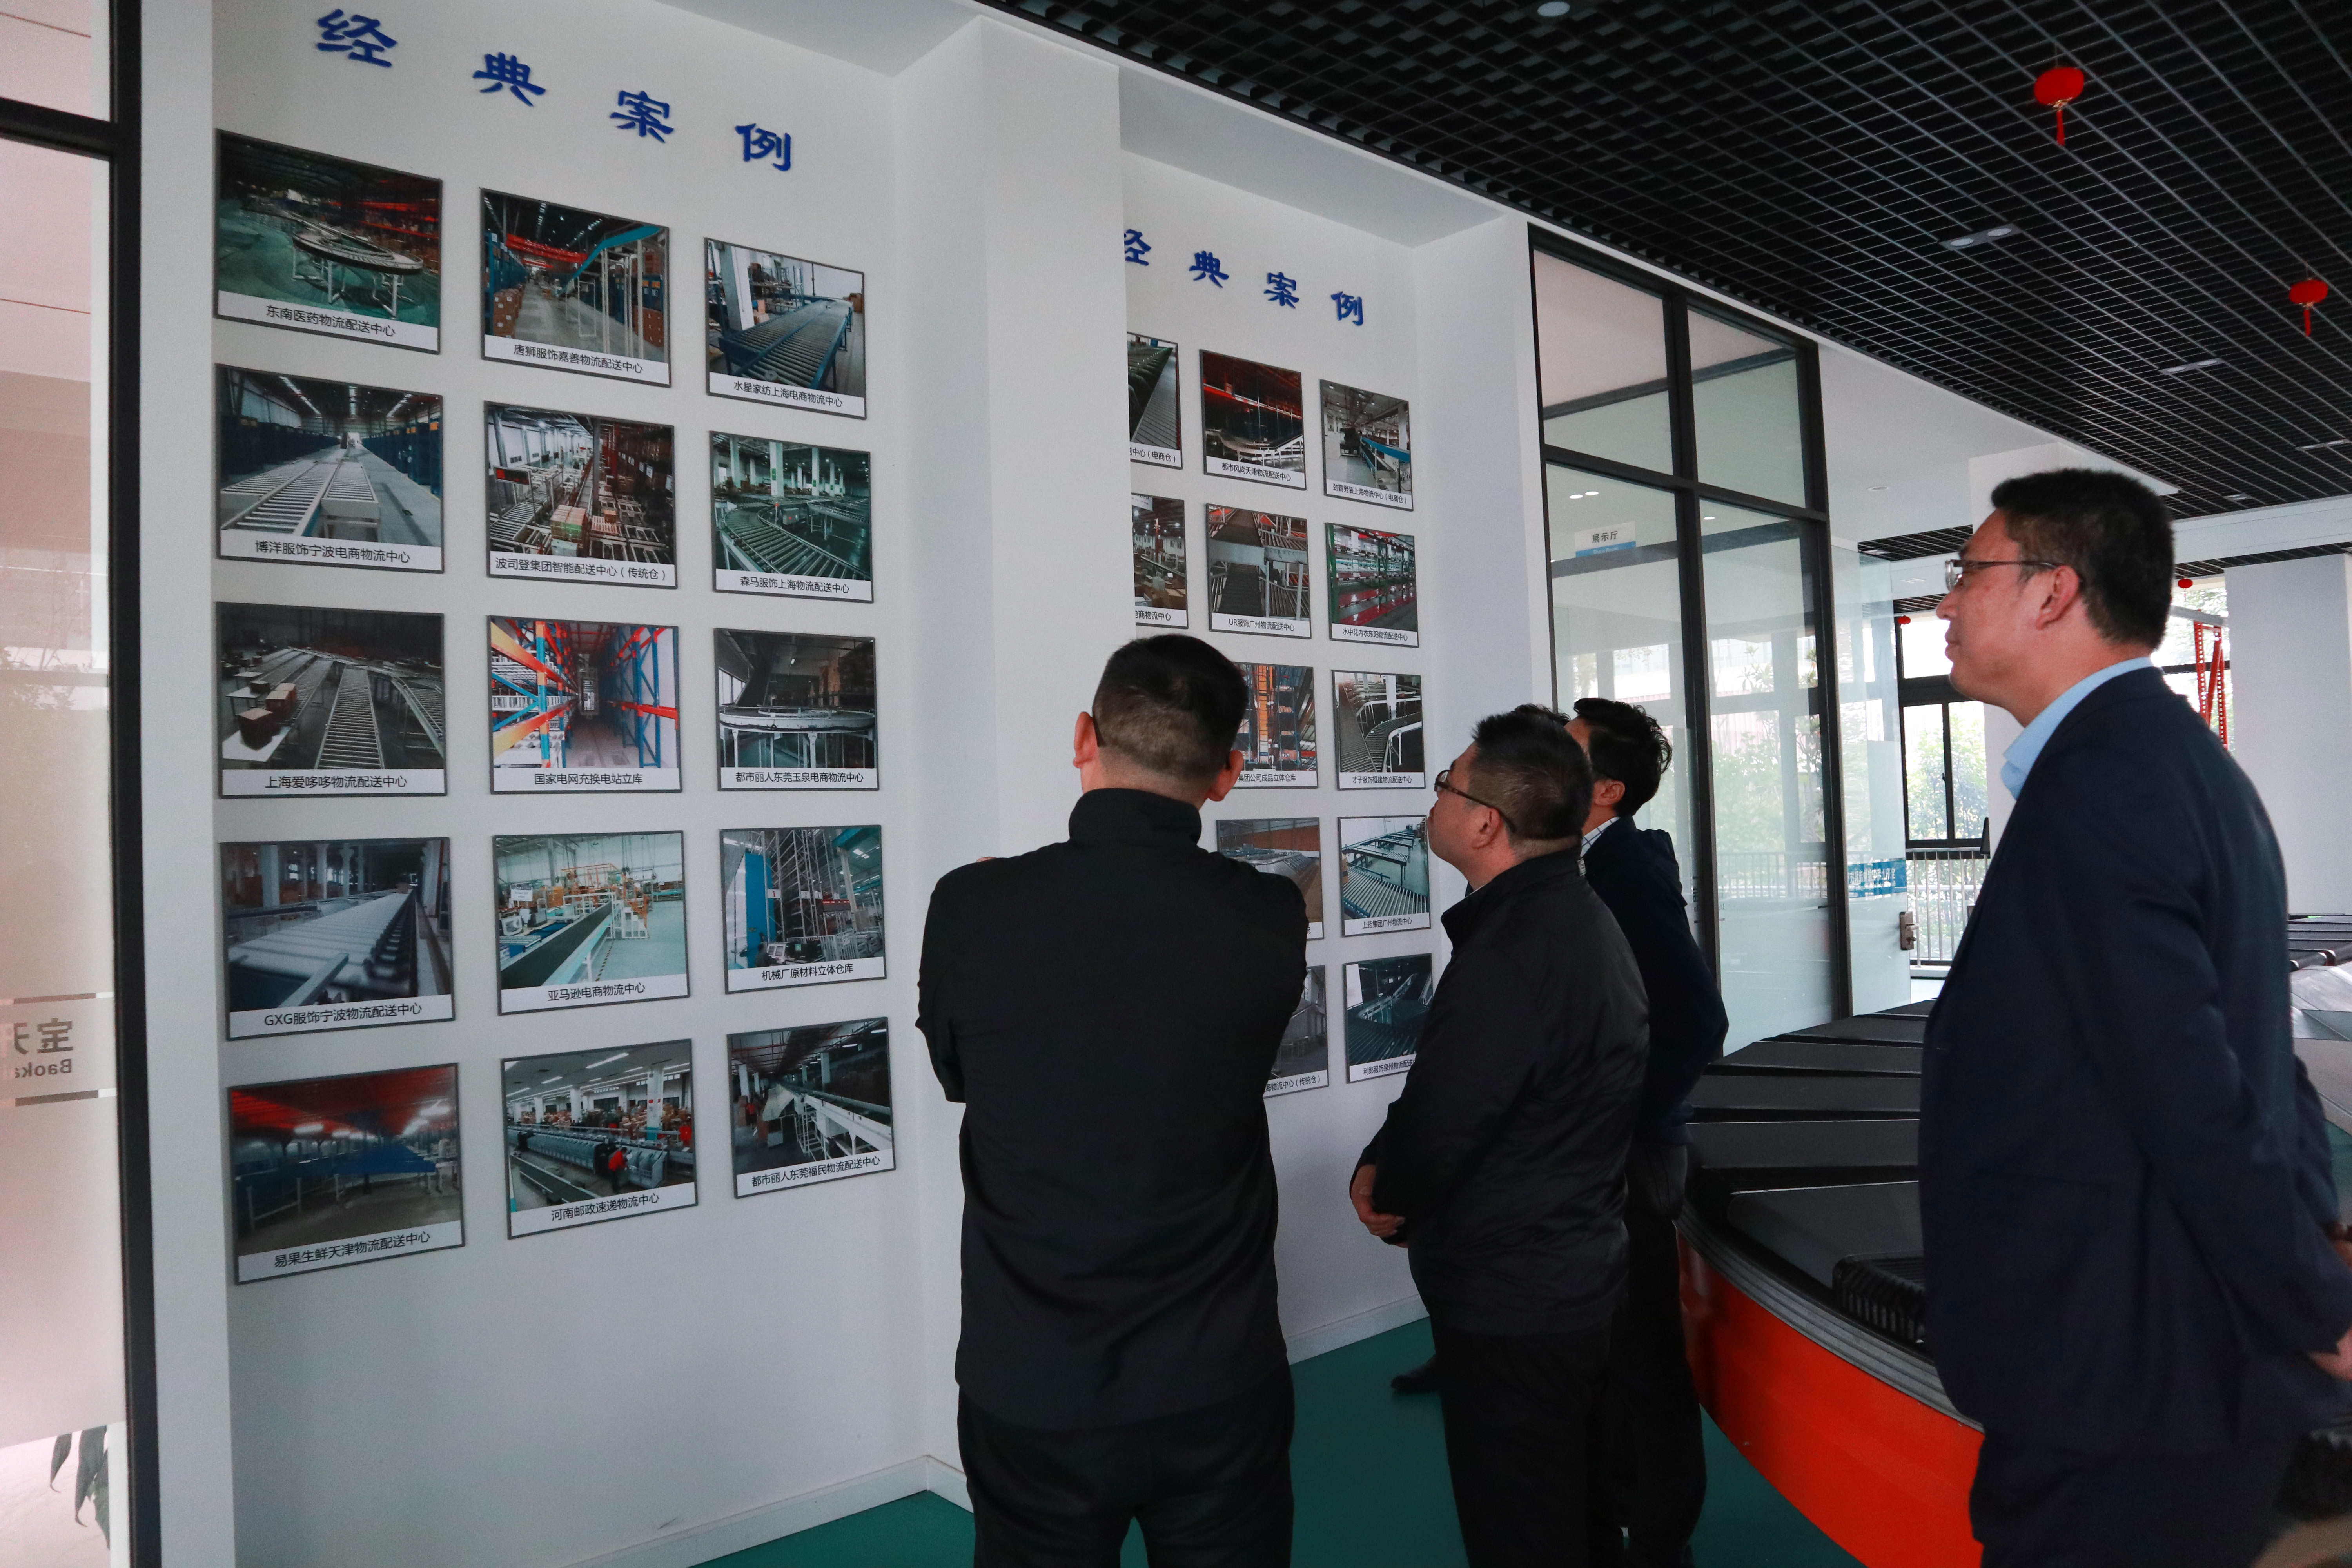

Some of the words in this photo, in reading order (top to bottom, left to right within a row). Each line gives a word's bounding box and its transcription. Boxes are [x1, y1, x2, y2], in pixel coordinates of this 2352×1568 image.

[316, 8, 794, 172] 经典案例
[266, 304, 395, 337] 东南医药物流配送中心
[514, 344, 643, 374] 唐狮服饰嘉善物流配送中心
[733, 381, 843, 407] 水星家纺上海电商物流中心
[1222, 462, 1291, 481] 都市风尚天津物流配送中心
[1592, 531, 1618, 543] 展示厅
[255, 540, 410, 563] 博洋服饰宁波电商物流中心
[740, 576, 850, 594] 森马服饰上海物流配送中心
[1229, 618, 1295, 632] UR服饰广州物流配送中心
[1343, 628, 1408, 641] 水中花内衣东阳物流配送中心
[264, 775, 408, 788] 上海爱哆哆物流配送中心
[534, 773, 643, 785] 国家电网充换电站立库
[735, 771, 864, 783] 都市丽人东莞玉泉电商物流中心
[1352, 775, 1412, 784] 才子服饰福建物流配送中心
[1362, 917, 1412, 929] 上药集团广州物流中心
[761, 963, 853, 981] 机械厂原材料立体仓库
[547, 982, 646, 1002] 亚马逊电商物流中心
[264, 1002, 422, 1026] GXG服饰宁波物流配送中心
[1363, 1060, 1416, 1075] 利郎服饰泉州物流配送
[751, 1155, 880, 1187] 都市丽人东莞福民物流配送中心
[551, 1192, 660, 1222] 河南邮政速递物流中心
[274, 1230, 430, 1268] 易果生鲜天津物流配送中心
